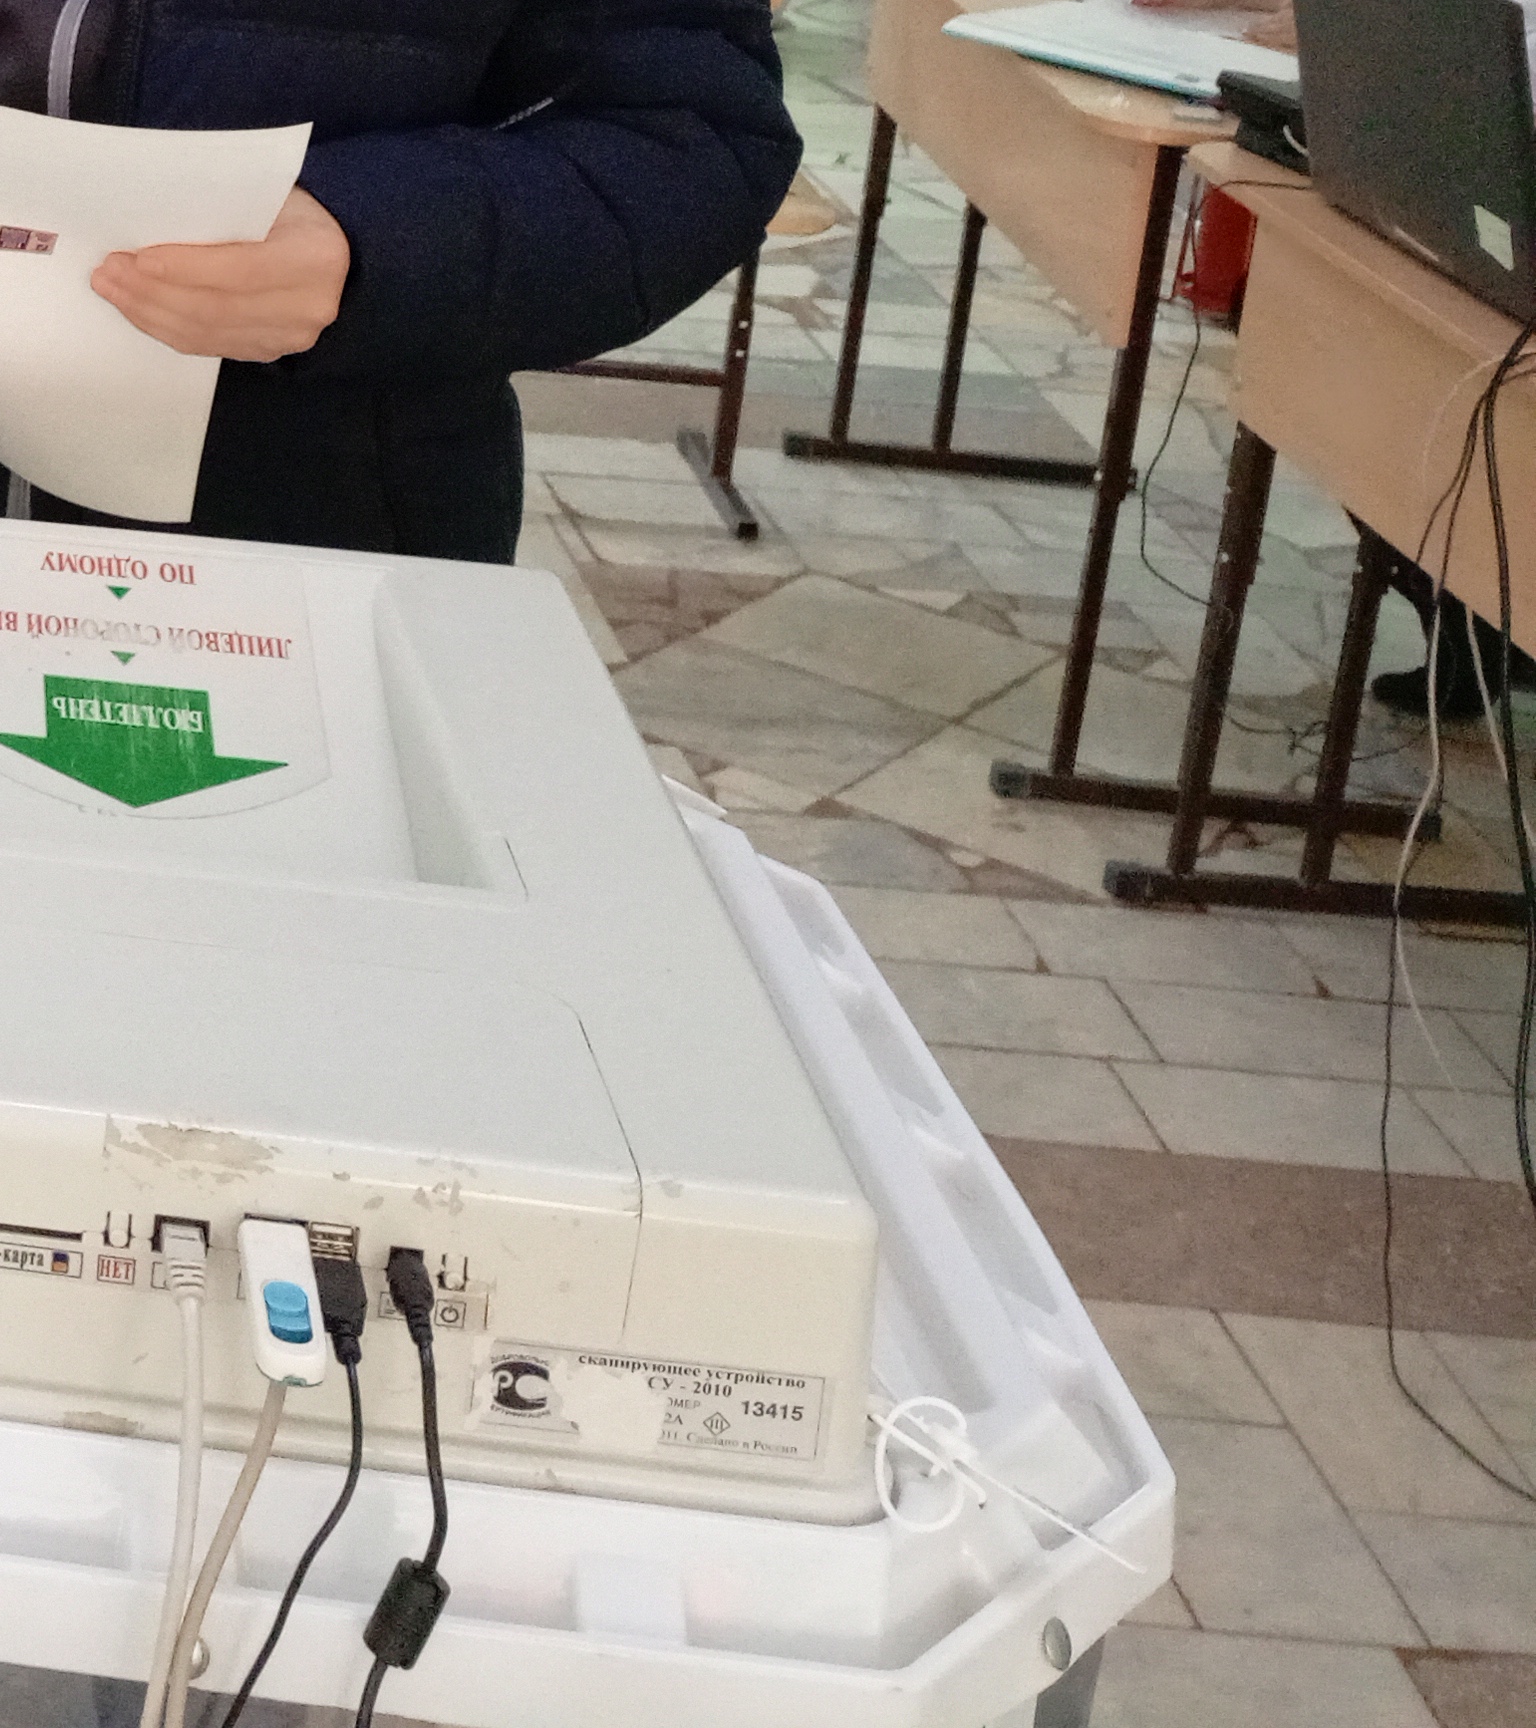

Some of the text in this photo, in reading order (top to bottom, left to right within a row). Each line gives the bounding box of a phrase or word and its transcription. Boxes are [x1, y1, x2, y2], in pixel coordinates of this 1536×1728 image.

[40, 550, 197, 585] ПО ОДНОМУ
[27, 612, 163, 647] СТОРОНОЙ
[168, 626, 292, 659] ЛИЦЕВОЙ
[53, 696, 204, 733] БЮЛЛЕТЕНЬ
[99, 1256, 134, 1280] НЕТ
[578, 1354, 701, 1378] сканирующее
[707, 1368, 806, 1391] устройство
[693, 1381, 733, 1398] 2010
[741, 1400, 804, 1422] 13415
